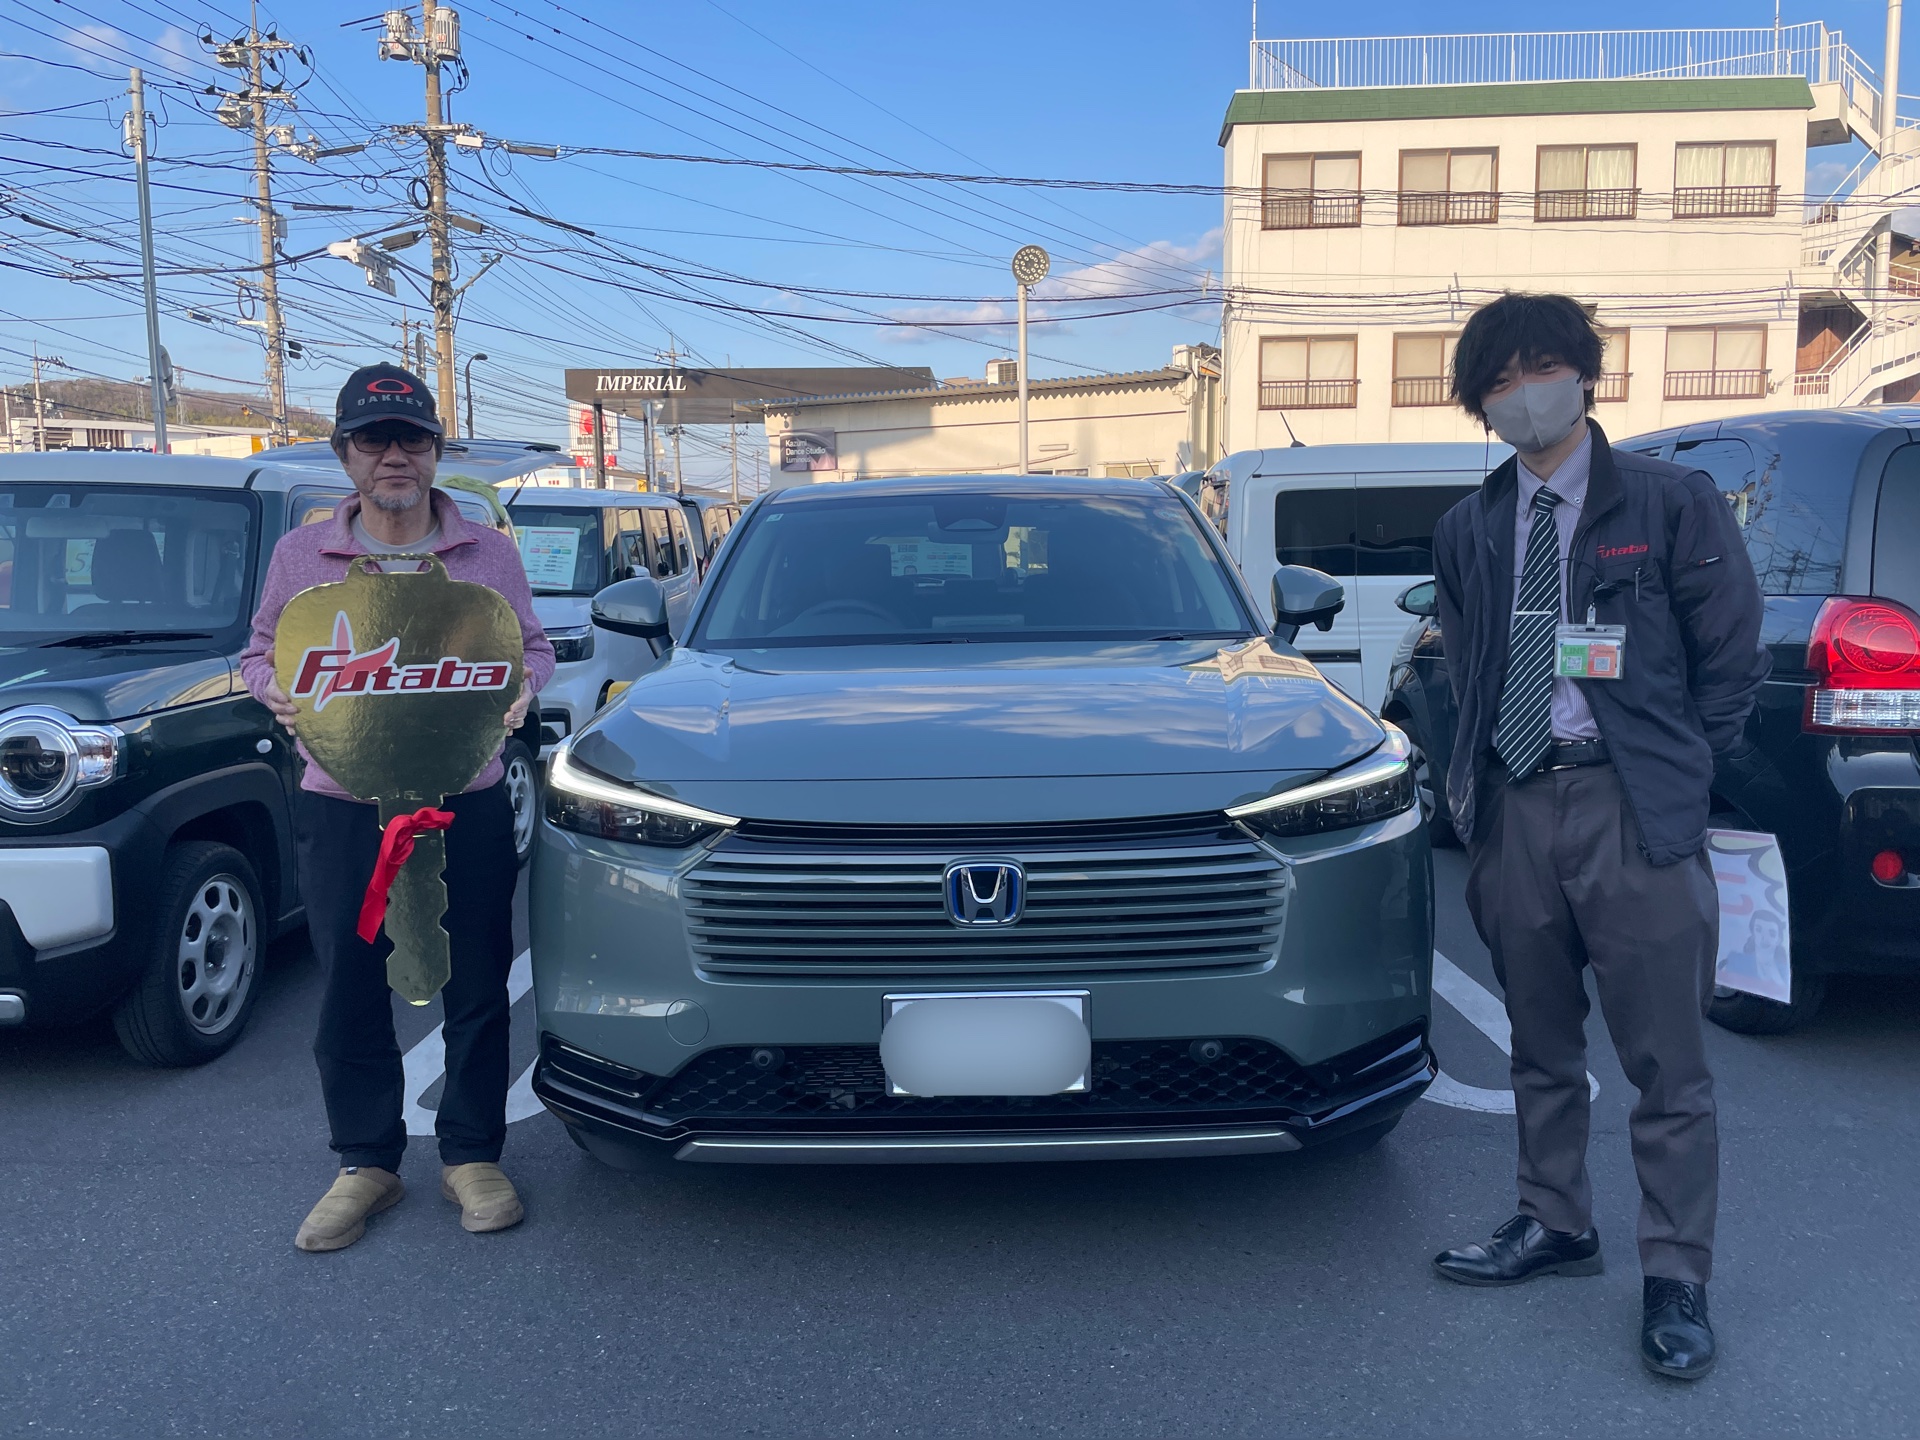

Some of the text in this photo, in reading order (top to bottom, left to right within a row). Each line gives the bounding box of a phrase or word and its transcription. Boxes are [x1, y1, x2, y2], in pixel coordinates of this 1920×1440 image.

[595, 375, 687, 391] IMPERIAL
[357, 394, 424, 407] OAKLEY
[785, 439, 807, 447] Kazumi
[785, 446, 826, 456] Dance Studio
[293, 648, 510, 696] Futaba
